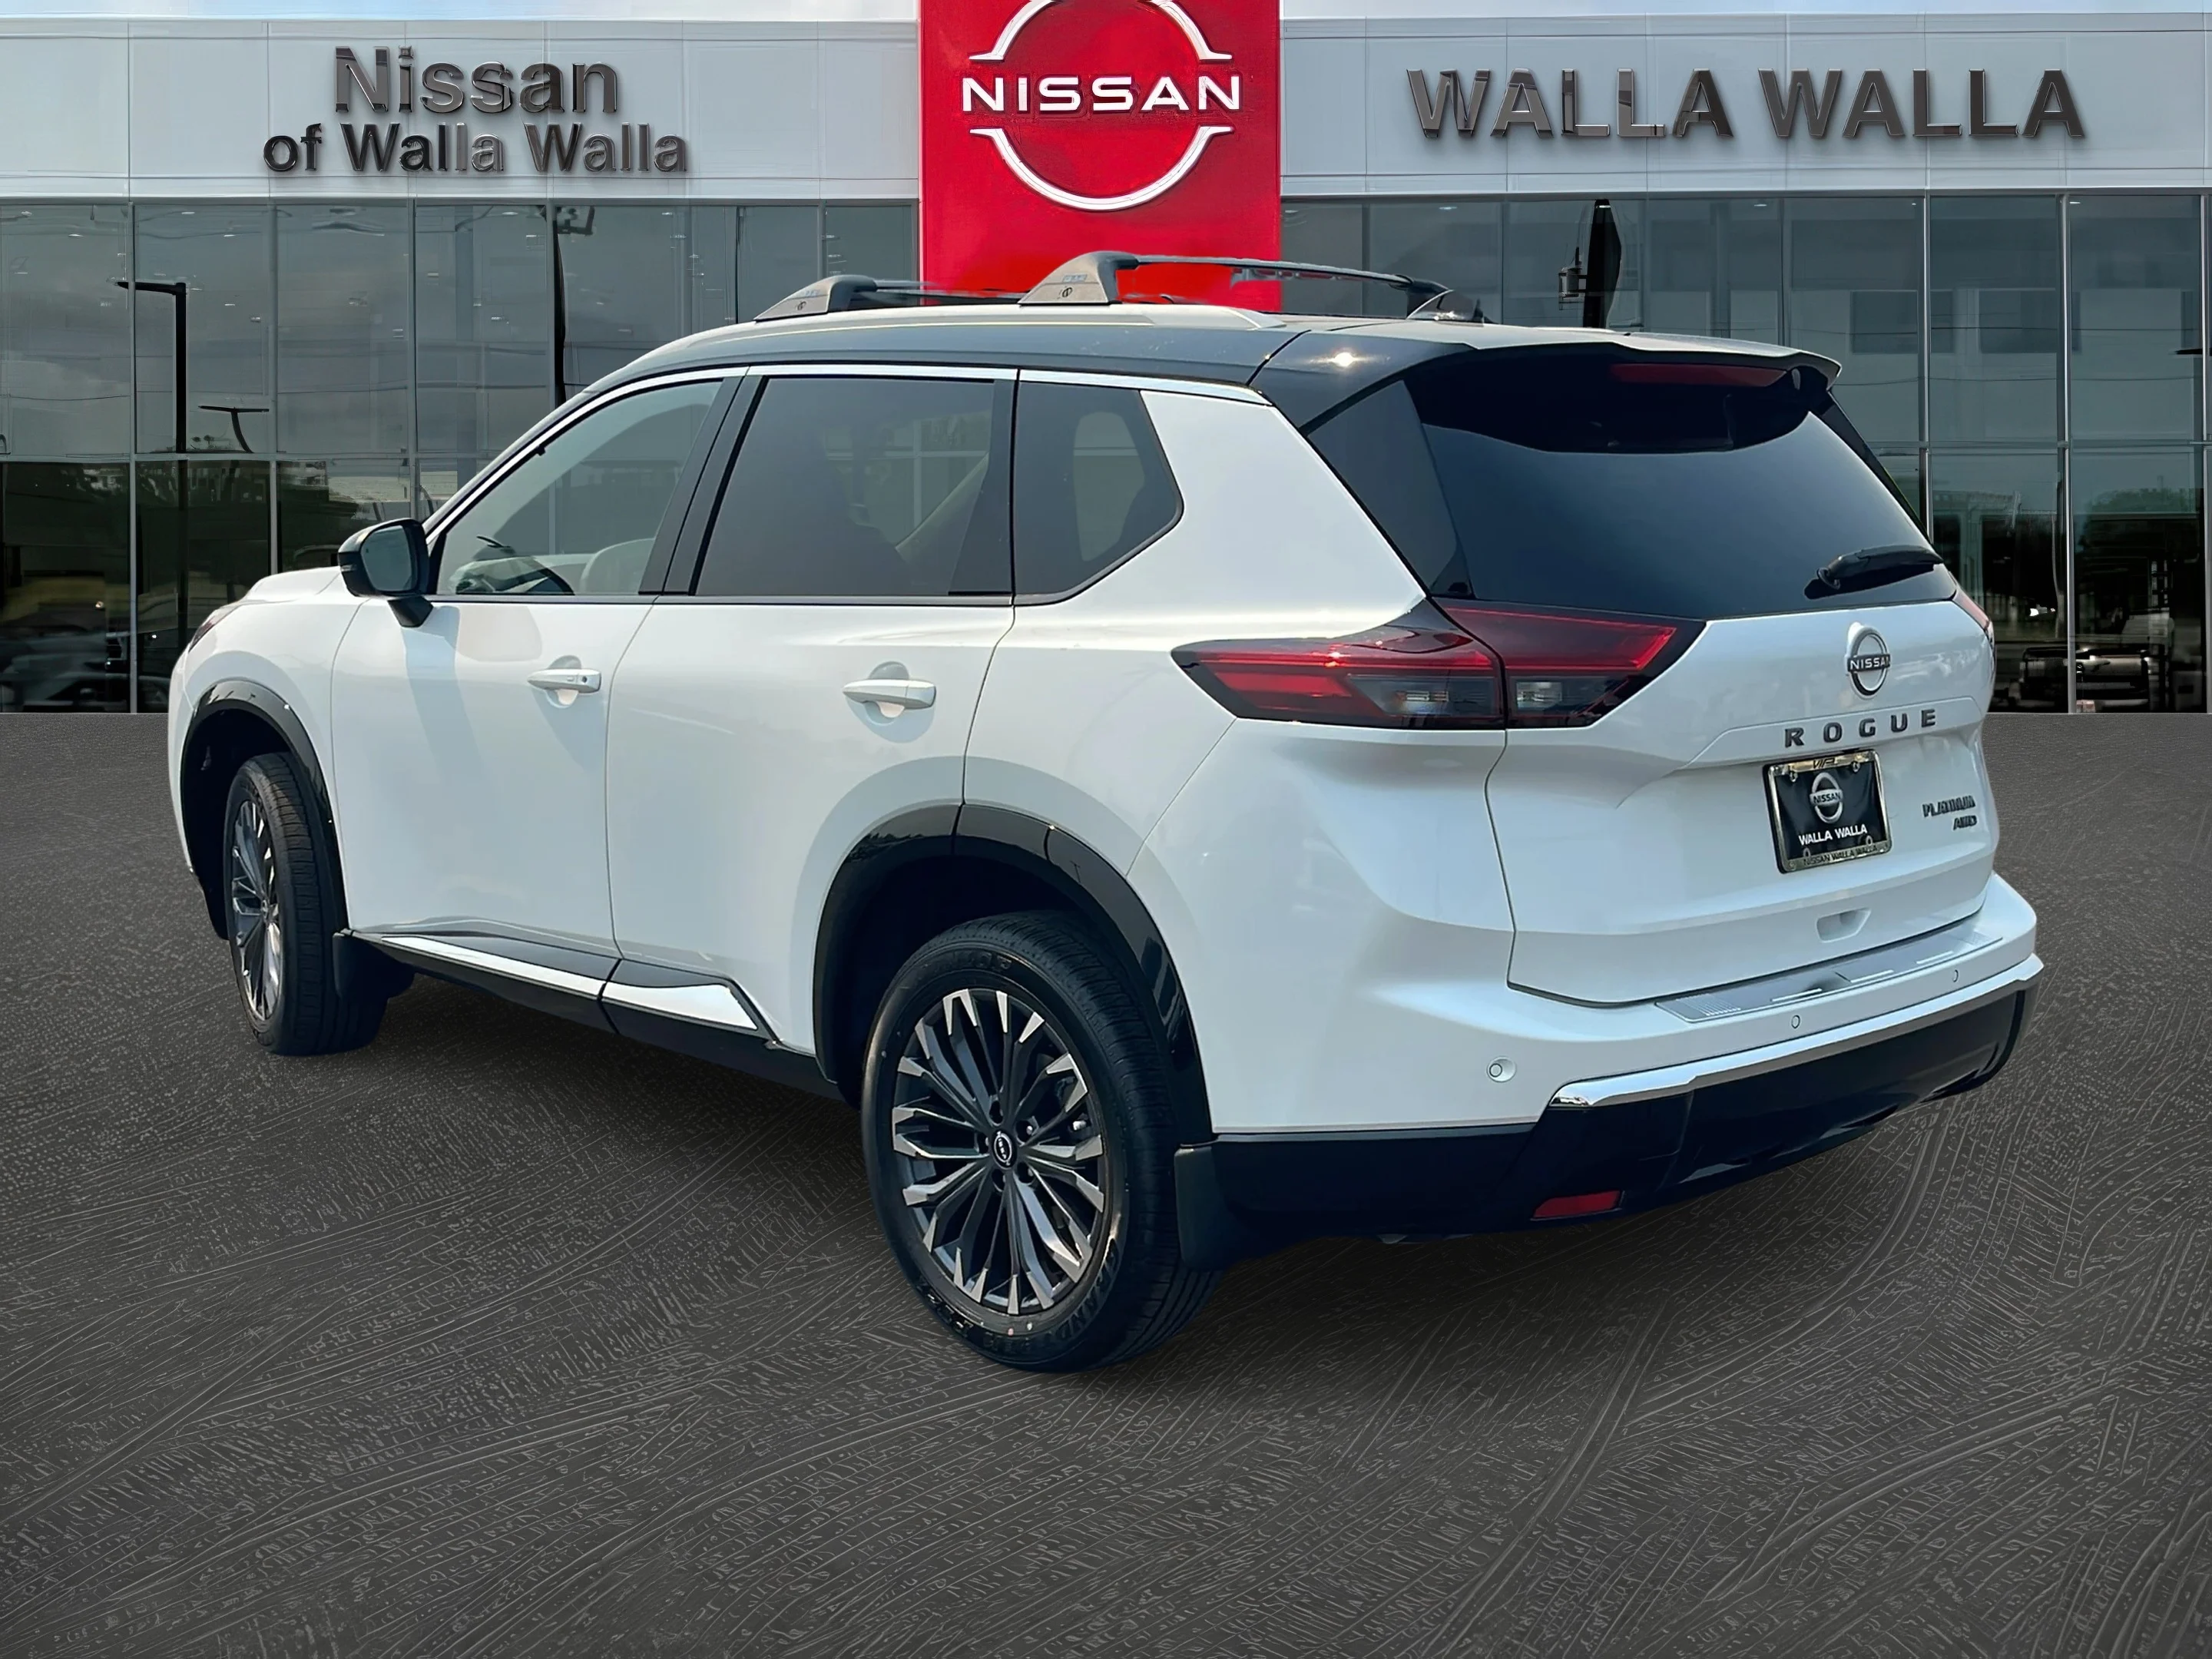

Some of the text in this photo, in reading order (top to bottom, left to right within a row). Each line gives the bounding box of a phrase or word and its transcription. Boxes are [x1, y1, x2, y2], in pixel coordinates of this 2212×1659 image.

[335, 45, 619, 113] Nissan
[962, 76, 1240, 111] NISSAN
[1406, 68, 2085, 138] WALLA WALLA
[263, 122, 688, 172] of Walla Walla
[1784, 709, 1936, 748] ROGUE
[1813, 793, 1841, 803] NISSAN
[1799, 823, 1868, 846] WALLA WALLA
